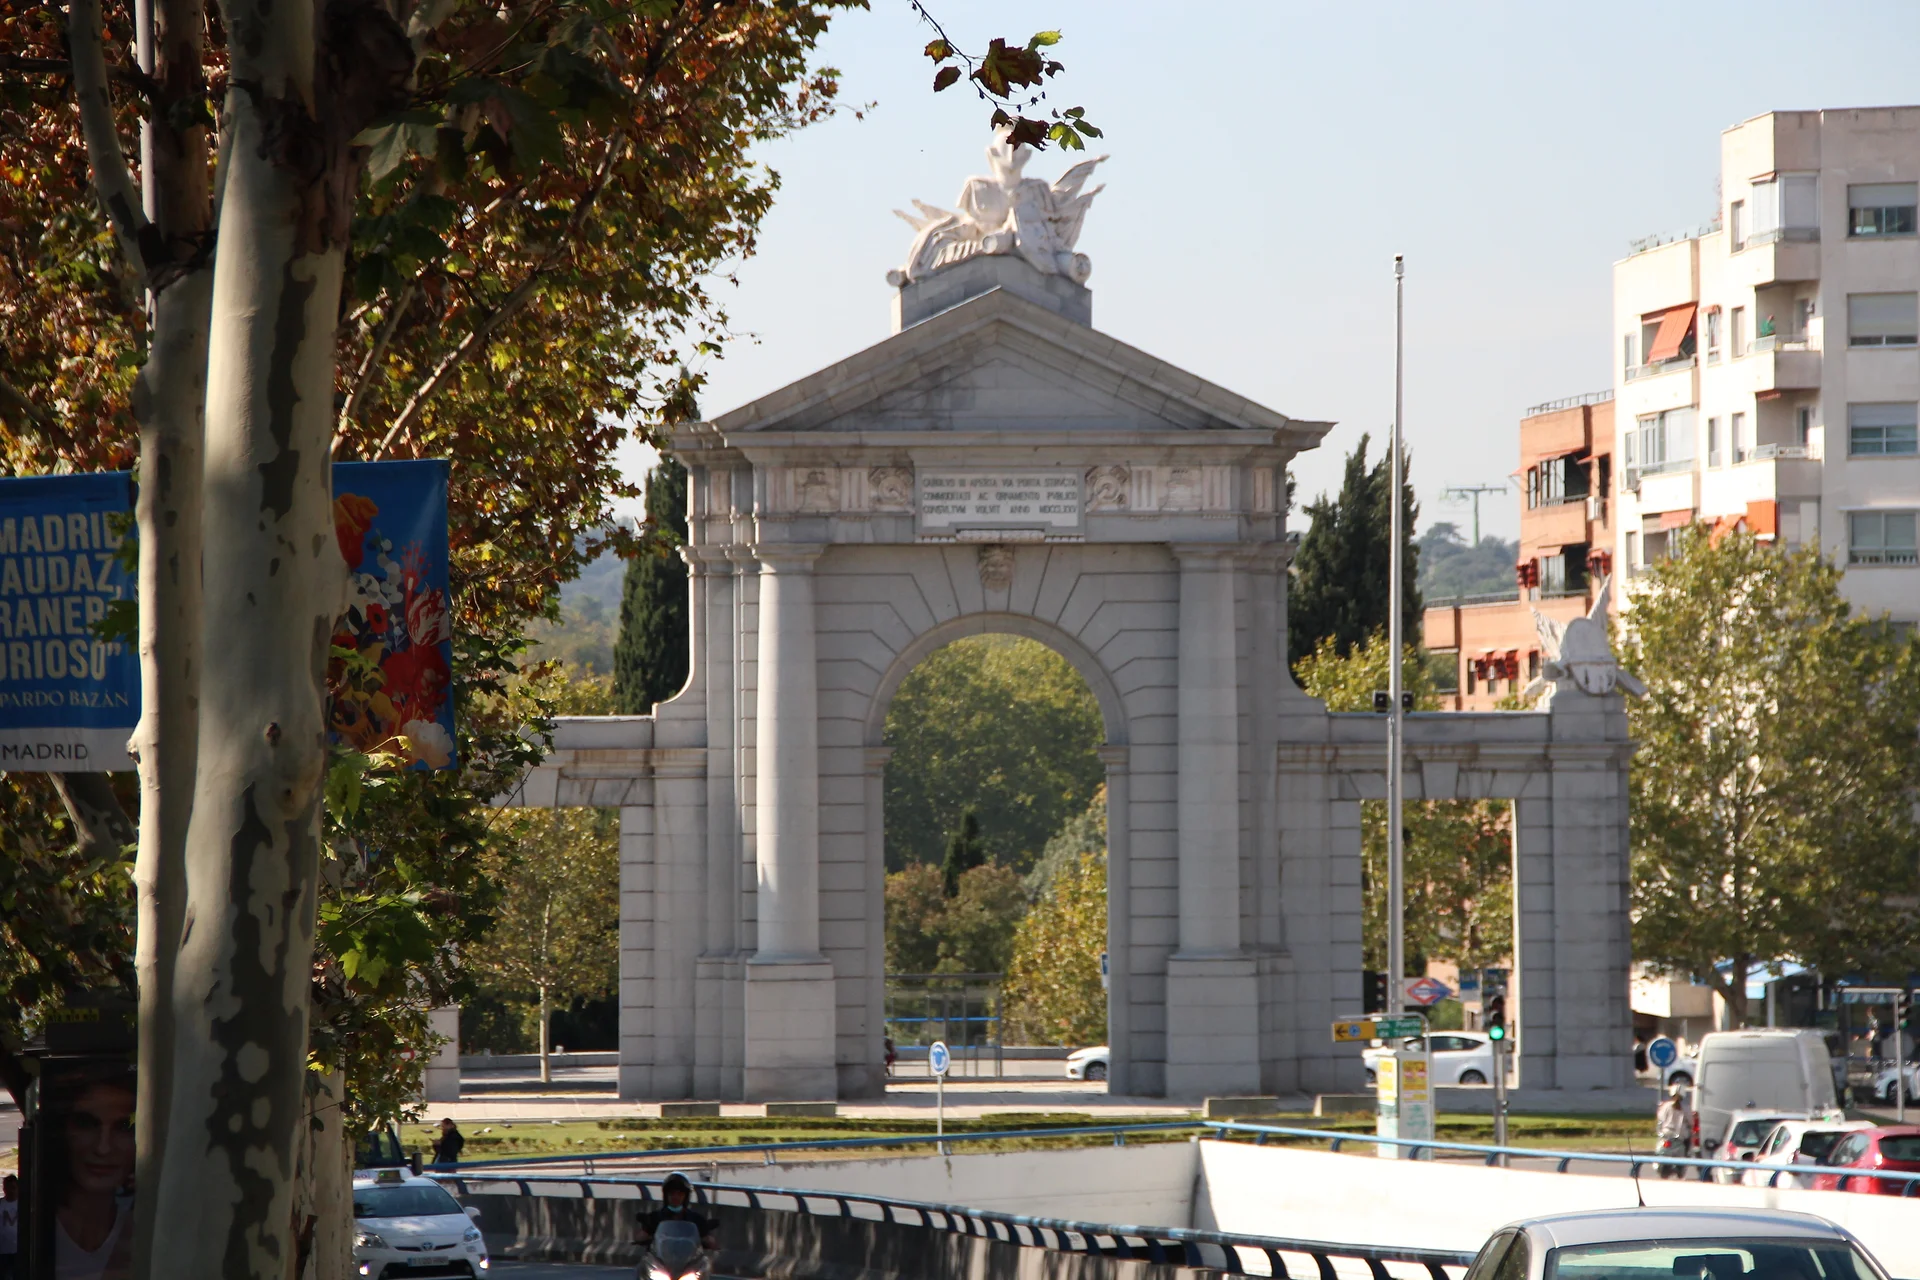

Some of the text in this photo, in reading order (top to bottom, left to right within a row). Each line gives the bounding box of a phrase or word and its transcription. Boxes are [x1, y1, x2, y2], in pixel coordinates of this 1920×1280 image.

[0, 510, 124, 554] MADRID
[1, 553, 122, 600] AUDAZ,
[0, 688, 129, 708] PARDO BAZÁN
[2, 742, 88, 760] MADRID
